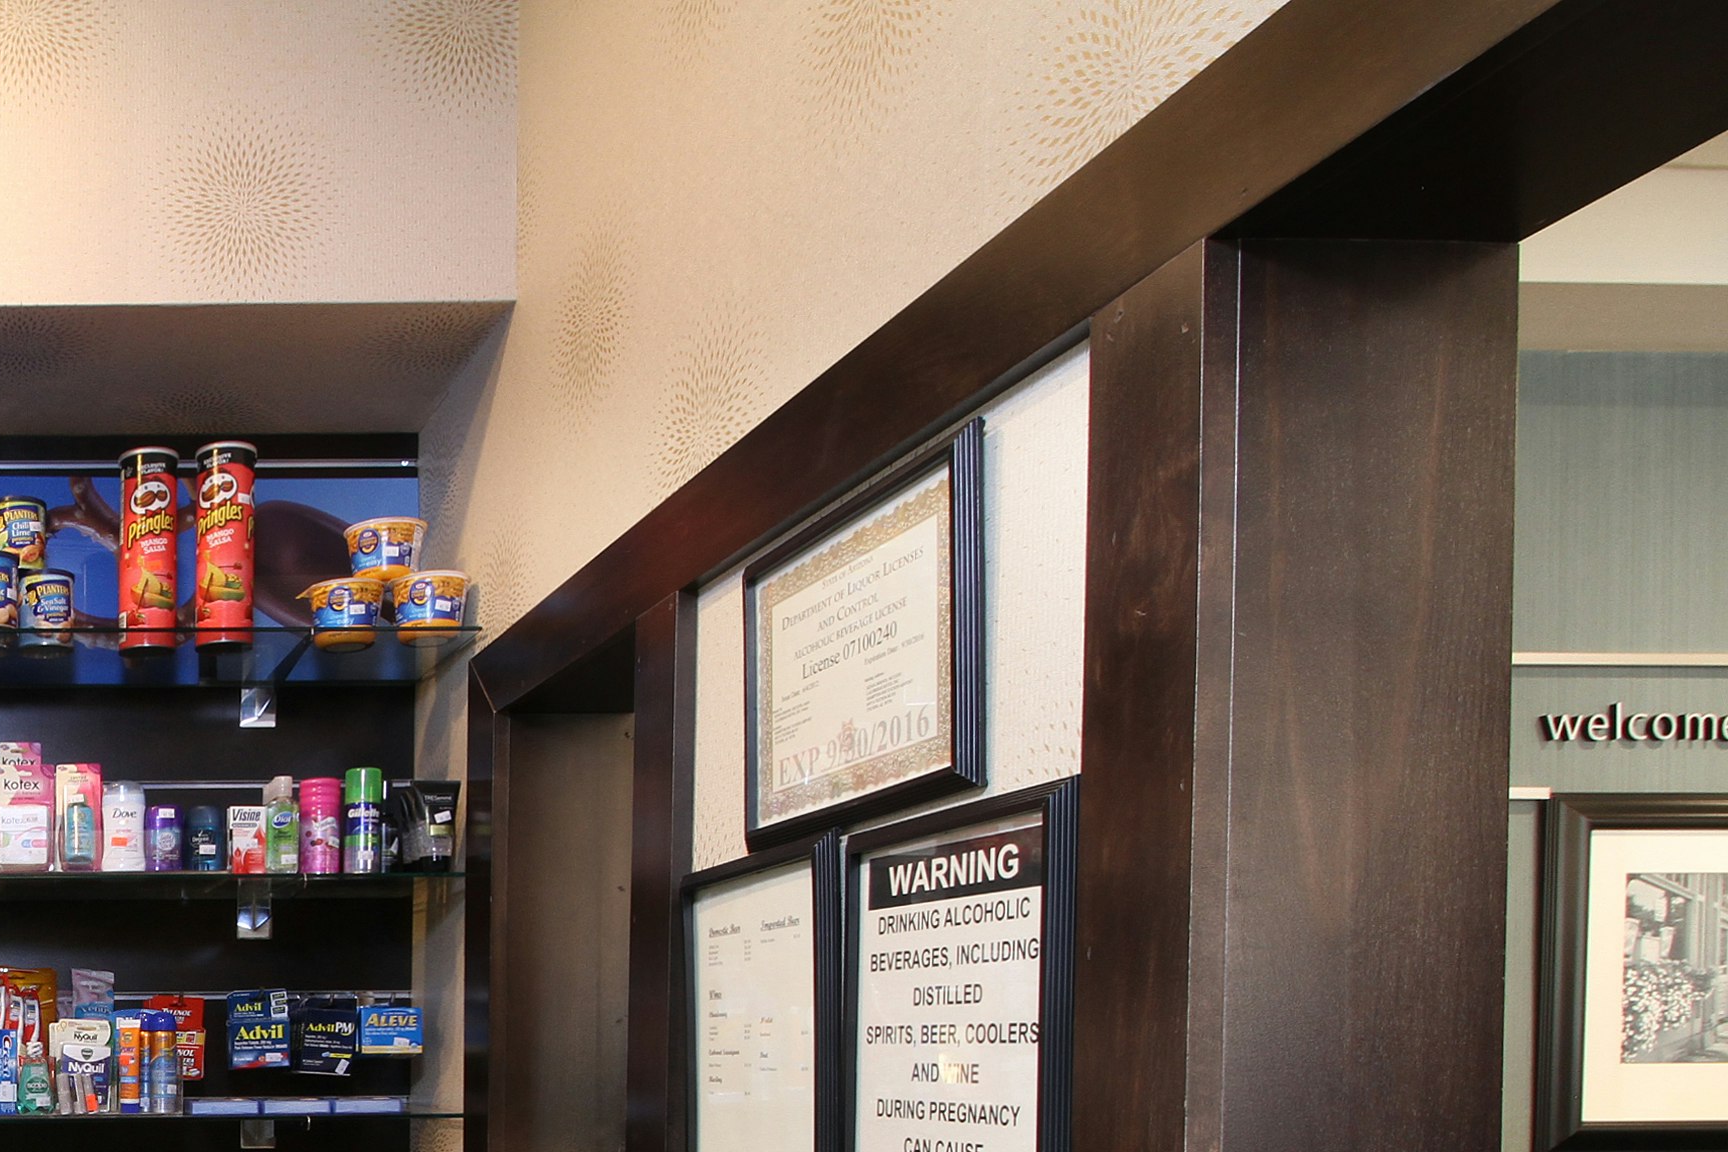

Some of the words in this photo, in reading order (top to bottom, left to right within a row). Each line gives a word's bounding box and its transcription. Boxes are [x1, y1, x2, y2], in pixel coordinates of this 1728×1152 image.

[4, 509, 38, 522] PLANTERS
[197, 500, 243, 545] Pringles
[12, 529, 31, 537] Lime
[127, 510, 174, 549] Pringles
[36, 585, 70, 597] PLANTERS
[781, 597, 832, 631] DEPARTMENT
[834, 590, 846, 603] OF
[847, 569, 881, 596] LIQUOR
[883, 546, 924, 578] LICENSES
[817, 615, 835, 633] AND
[837, 593, 879, 622] CONTROL
[794, 630, 835, 661] ALCOHOLIC
[836, 613, 873, 640] BEVERAGE
[874, 596, 908, 621] LICENSE
[802, 641, 840, 680] License
[842, 620, 898, 662] 07100240
[1543, 701, 1728, 741] welcom
[779, 746, 821, 787] EXP
[3, 778, 40, 791] kotex
[112, 808, 138, 819] Dove
[232, 808, 261, 822] Visine
[888, 843, 1020, 897] WARNING
[878, 909, 940, 935] DRINKING
[944, 897, 1031, 928] ALCOHOLIC
[870, 946, 952, 972] BEVERAGES,
[956, 937, 1039, 966] INCLUDING
[913, 983, 983, 1006] DISTILLED
[234, 1001, 262, 1012] Advil
[306, 1022, 335, 1033] Advil
[335, 1021, 353, 1035] PM
[365, 1013, 418, 1027] ALEVE
[73, 1032, 98, 1042] NyQuil
[235, 1023, 284, 1041] Advil
[866, 1024, 917, 1047] SPIRITS,
[920, 1024, 961, 1047] BEER,
[965, 1021, 1039, 1044] COOLERS
[67, 1062, 105, 1074] NyQuil
[911, 1063, 940, 1083] AND
[876, 1098, 925, 1121] DURING
[929, 1101, 1021, 1127] PREGNANCY
